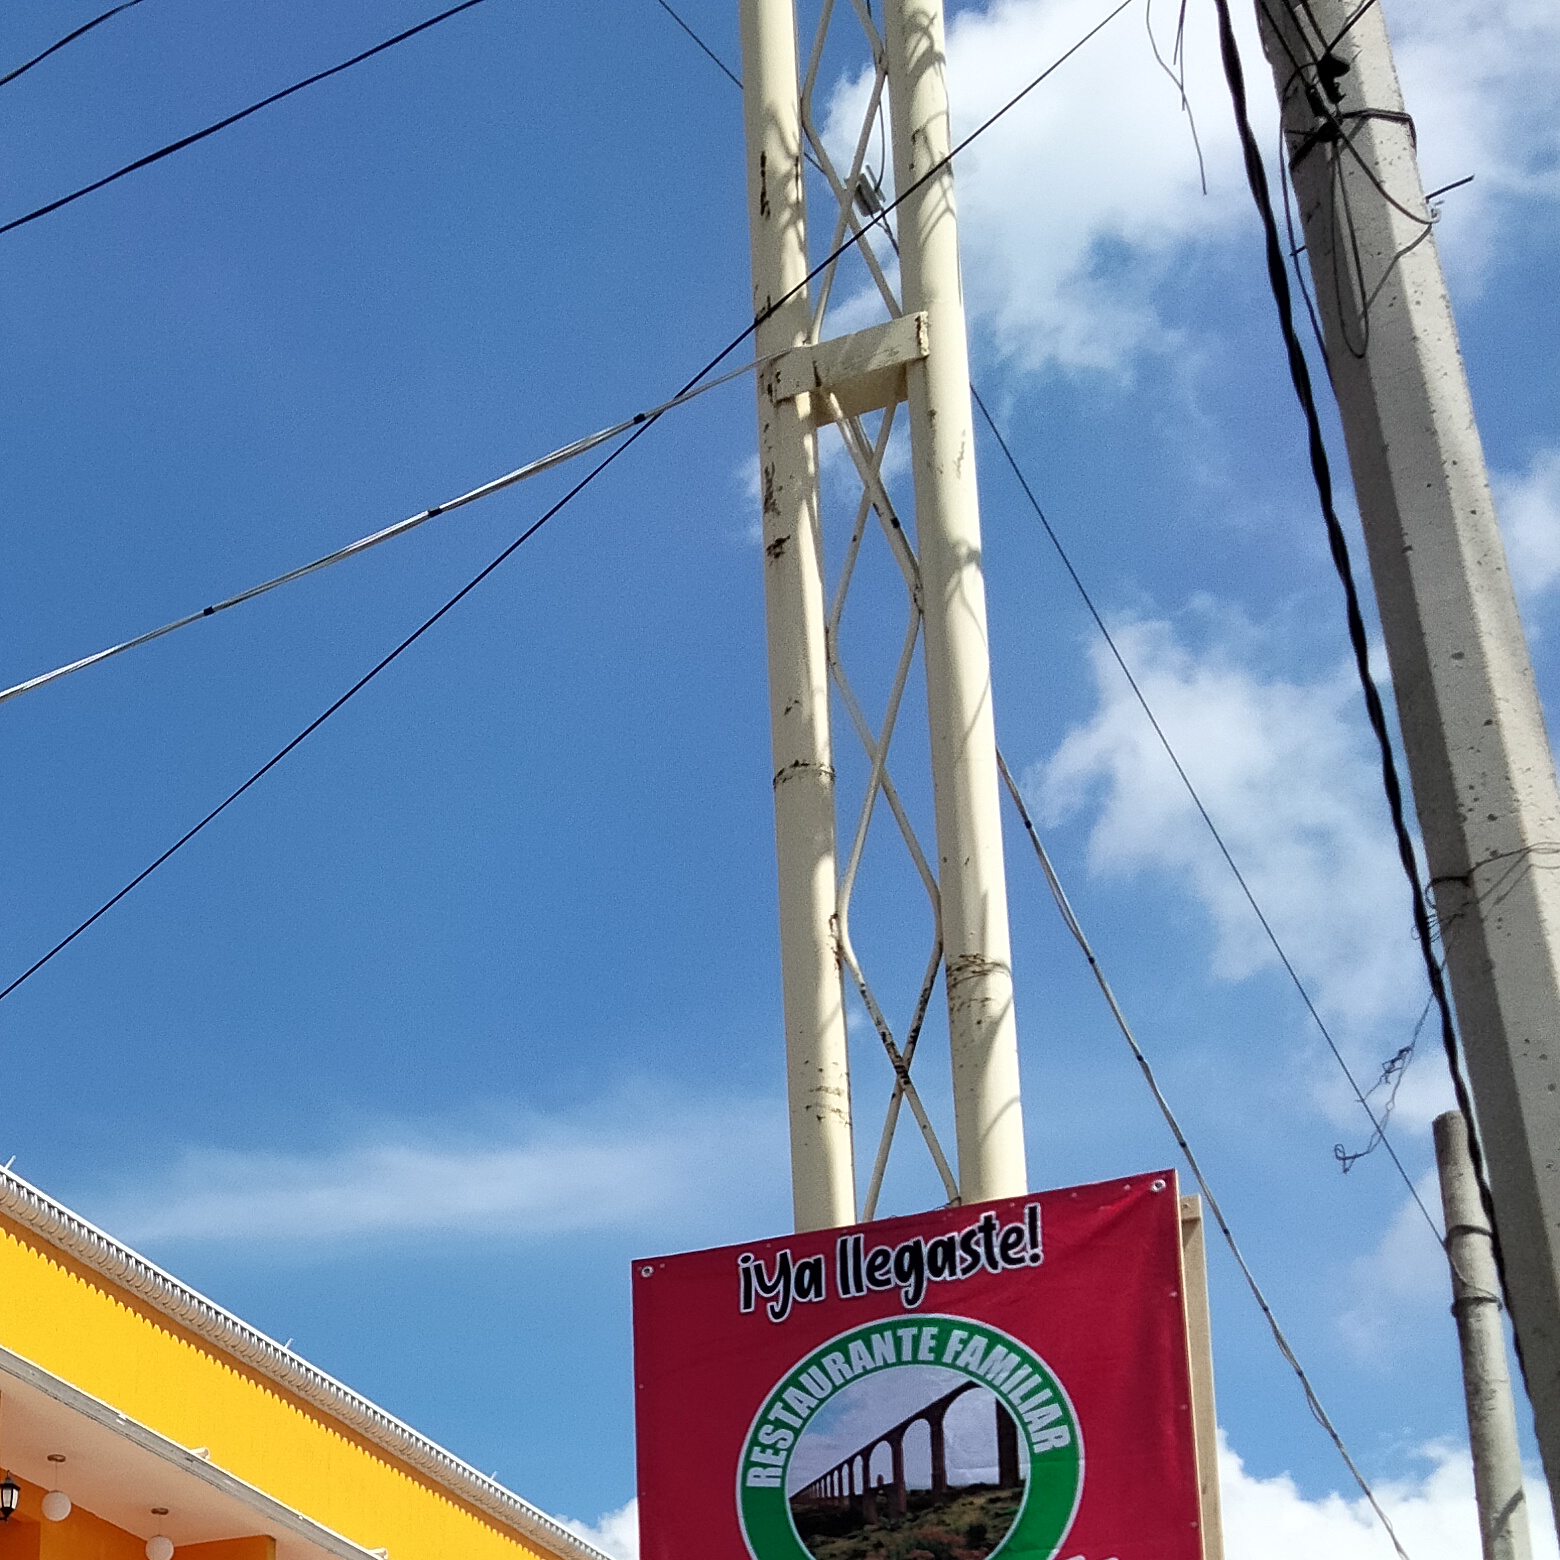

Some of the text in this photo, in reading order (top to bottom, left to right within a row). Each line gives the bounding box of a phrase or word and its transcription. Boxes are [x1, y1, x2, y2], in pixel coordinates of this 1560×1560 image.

[836, 1203, 1045, 1308] llegaste!
[746, 1327, 1071, 1487] RESTAURANTE FAMILIAR
